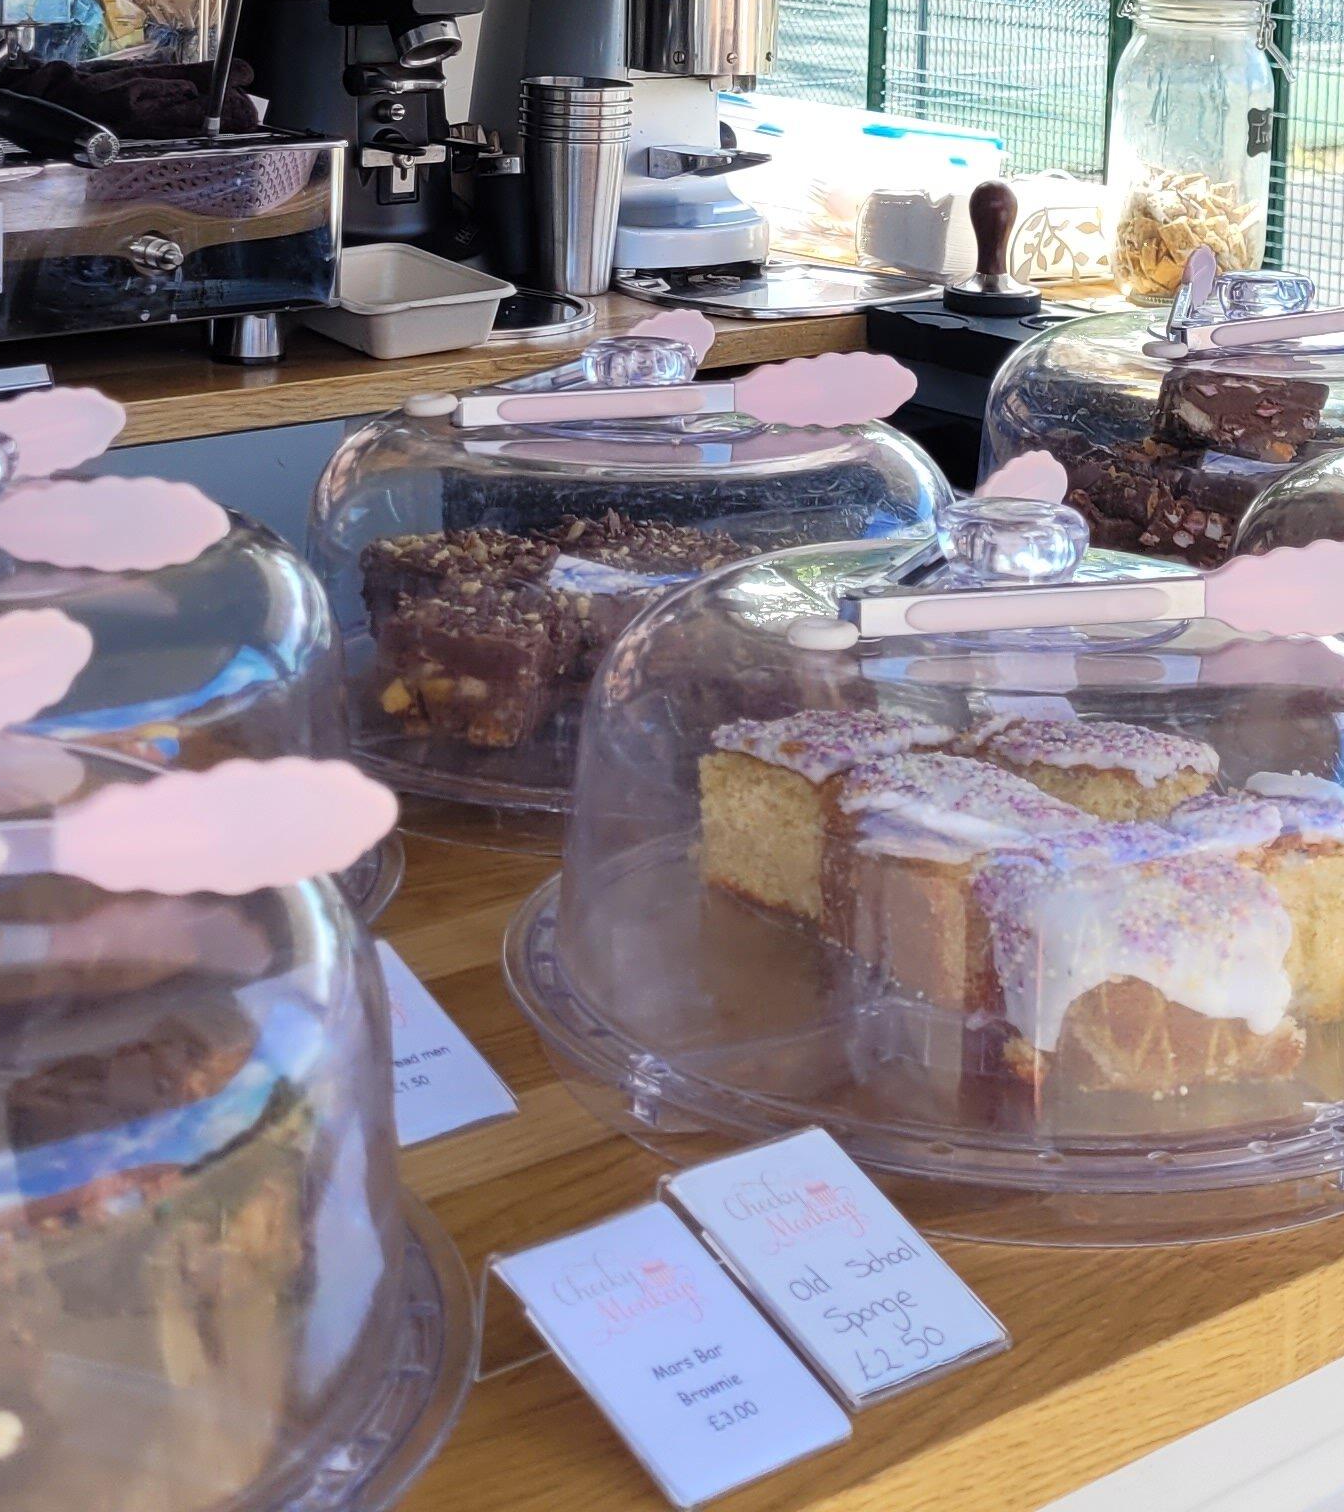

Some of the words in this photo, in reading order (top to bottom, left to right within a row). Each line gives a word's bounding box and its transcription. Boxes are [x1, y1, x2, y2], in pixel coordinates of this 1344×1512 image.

[789, 1265, 832, 1301] Old
[845, 1237, 921, 1278] School
[824, 1291, 919, 1338] Sponge
[651, 1358, 694, 1381] Mars
[693, 1344, 723, 1364] Bar
[676, 1373, 744, 1407] Brownie
[707, 1400, 760, 1432] £3.00
